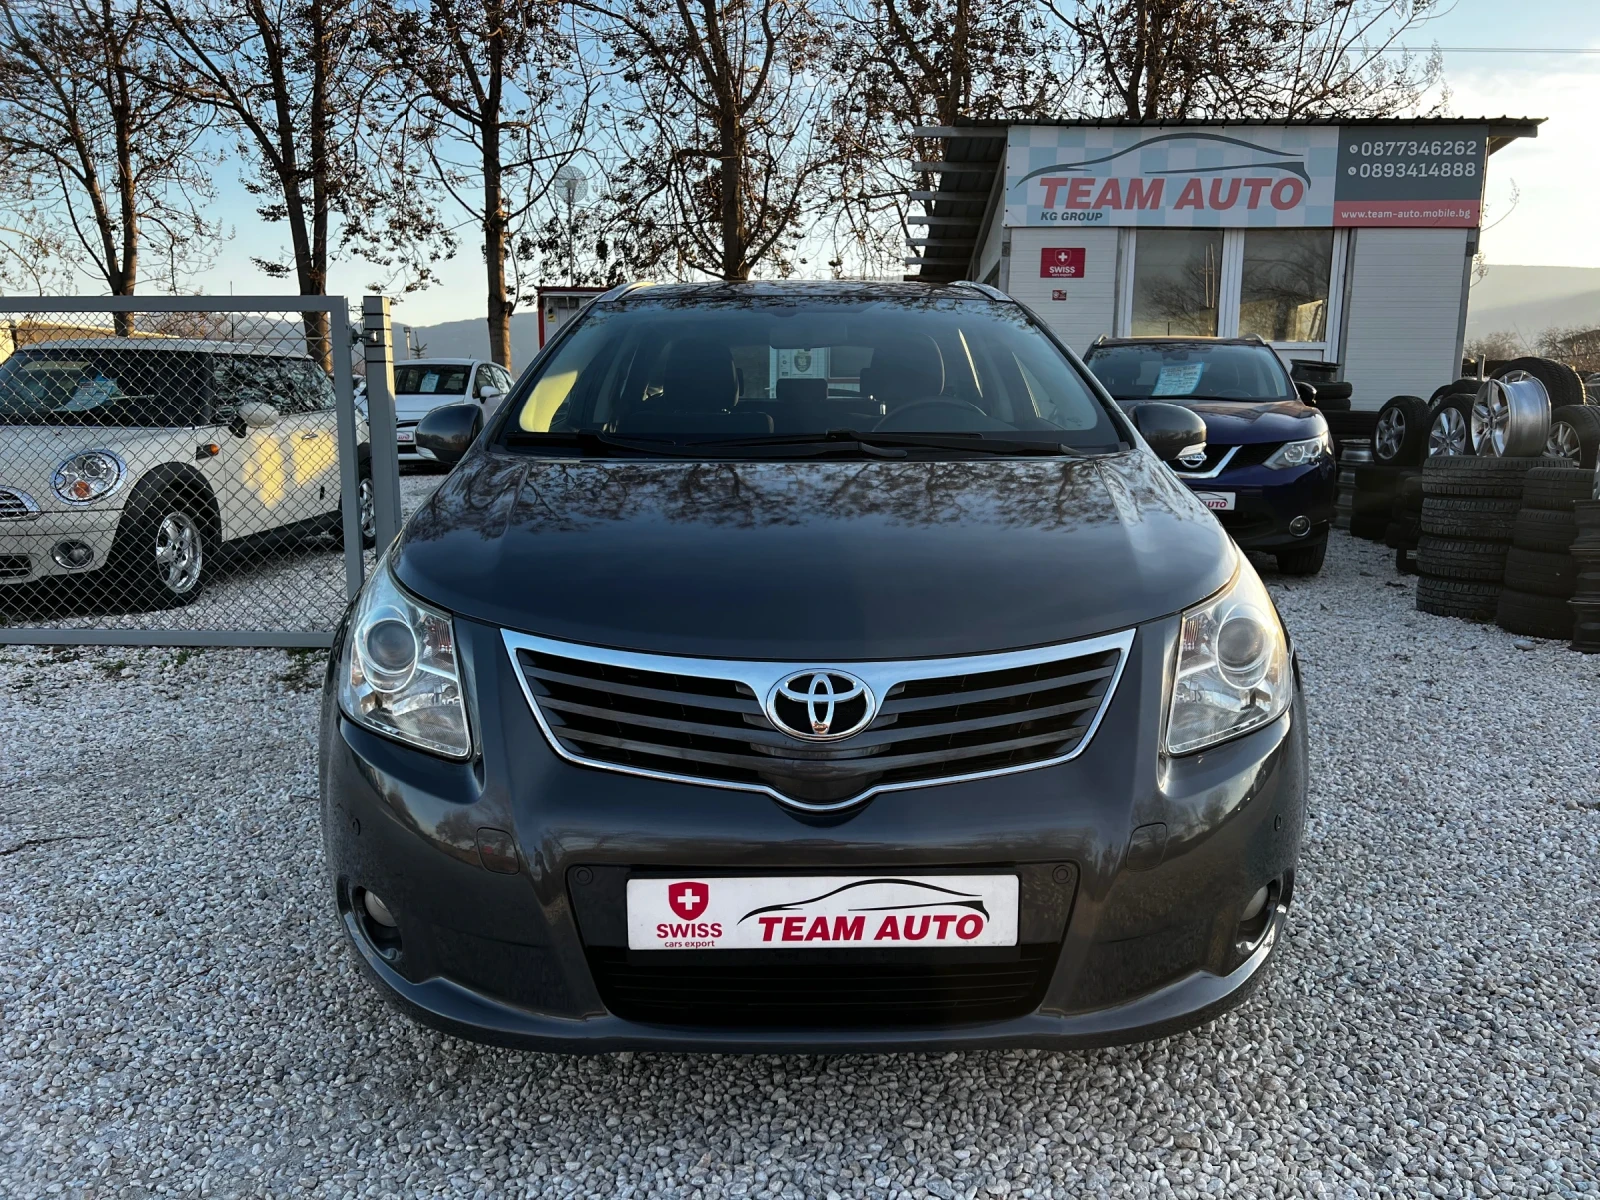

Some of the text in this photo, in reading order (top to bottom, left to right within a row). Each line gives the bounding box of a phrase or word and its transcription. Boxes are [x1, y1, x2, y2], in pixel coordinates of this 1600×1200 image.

[1361, 141, 1477, 156] 0877346262
[1359, 162, 1476, 178] 0893414888
[1039, 177, 1304, 210] TEAM AUTO
[1040, 212, 1103, 222] KG GROUP
[1341, 208, 1471, 219] www.team-auto.mobile.bg
[1049, 266, 1076, 274] SWISS
[656, 923, 723, 938] SWISS
[758, 914, 984, 942] TEAM AUTO
[685, 940, 715, 949] export
